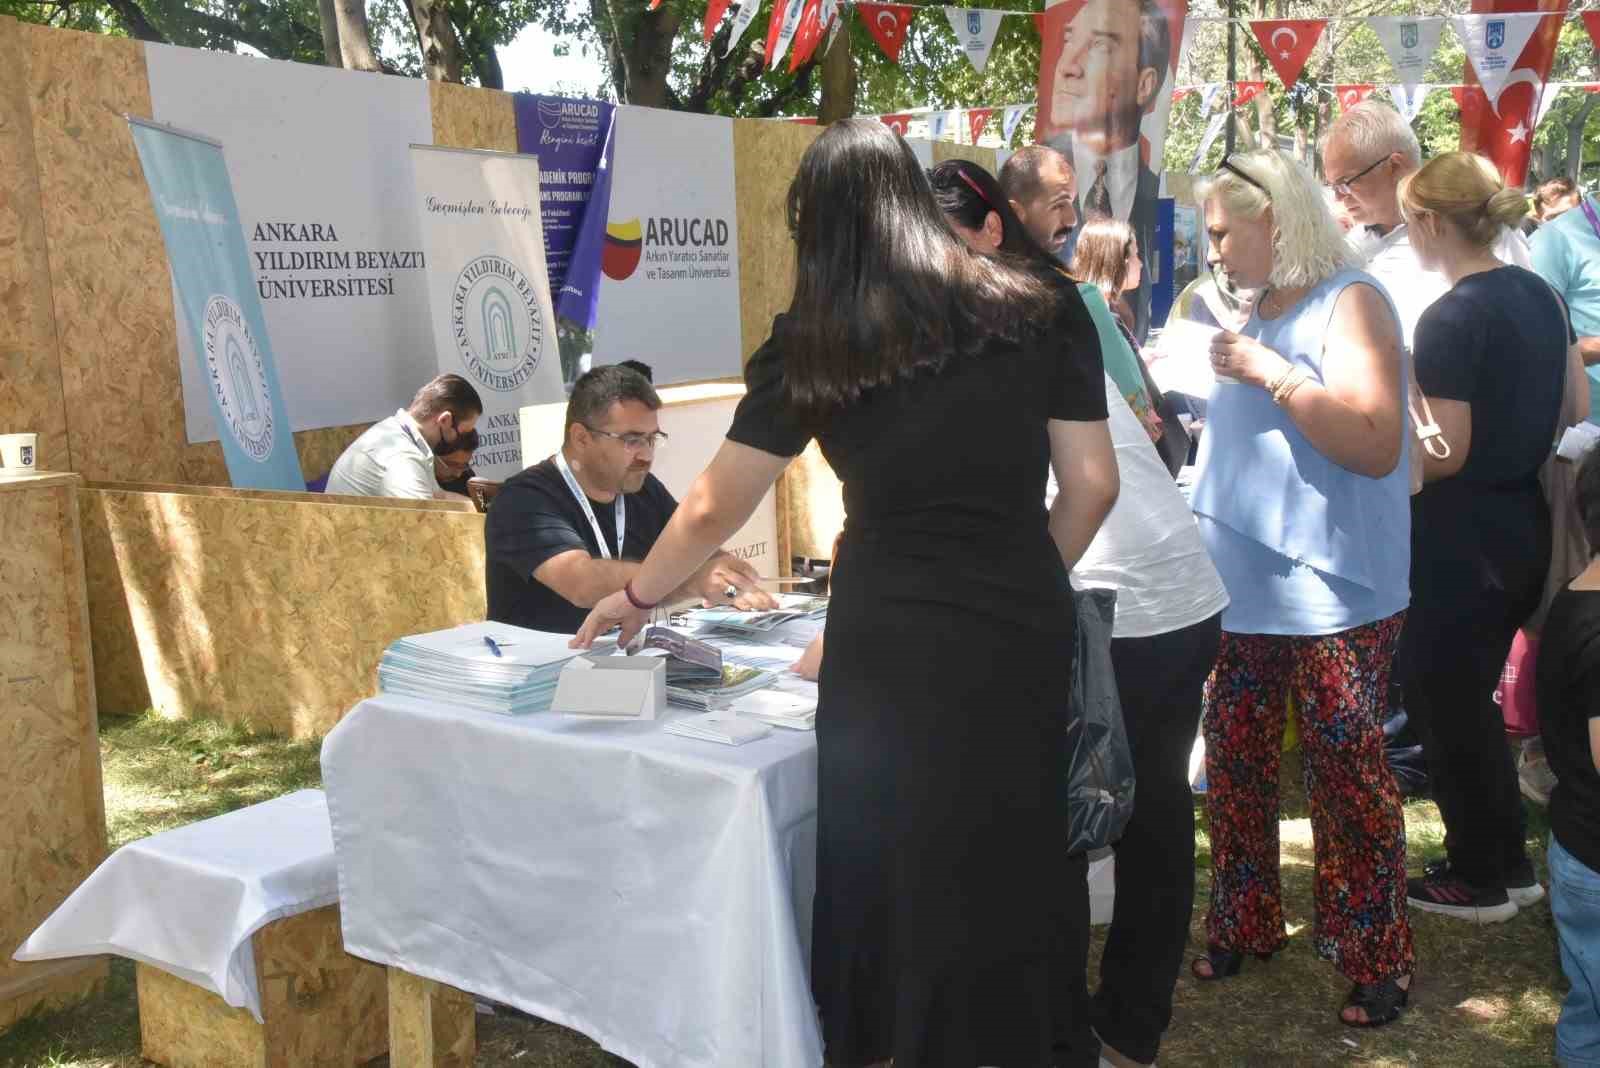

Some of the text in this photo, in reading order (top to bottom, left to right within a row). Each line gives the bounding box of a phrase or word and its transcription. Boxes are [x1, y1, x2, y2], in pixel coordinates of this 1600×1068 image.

[561, 102, 599, 118] ARUCAD
[540, 168, 568, 185] ADEMİK
[254, 222, 338, 242] ANKARA
[645, 217, 729, 247] ARUCAD
[255, 251, 350, 270] YILDIRIM
[646, 270, 656, 280] ve
[258, 273, 395, 300] ÜNİVERSİTESİ
[455, 285, 469, 347] ANKARA
[464, 259, 516, 283] YILDIRIM
[488, 412, 520, 429] ANKA
[479, 430, 514, 448] DIRIM
[733, 542, 768, 560] YAZIT
